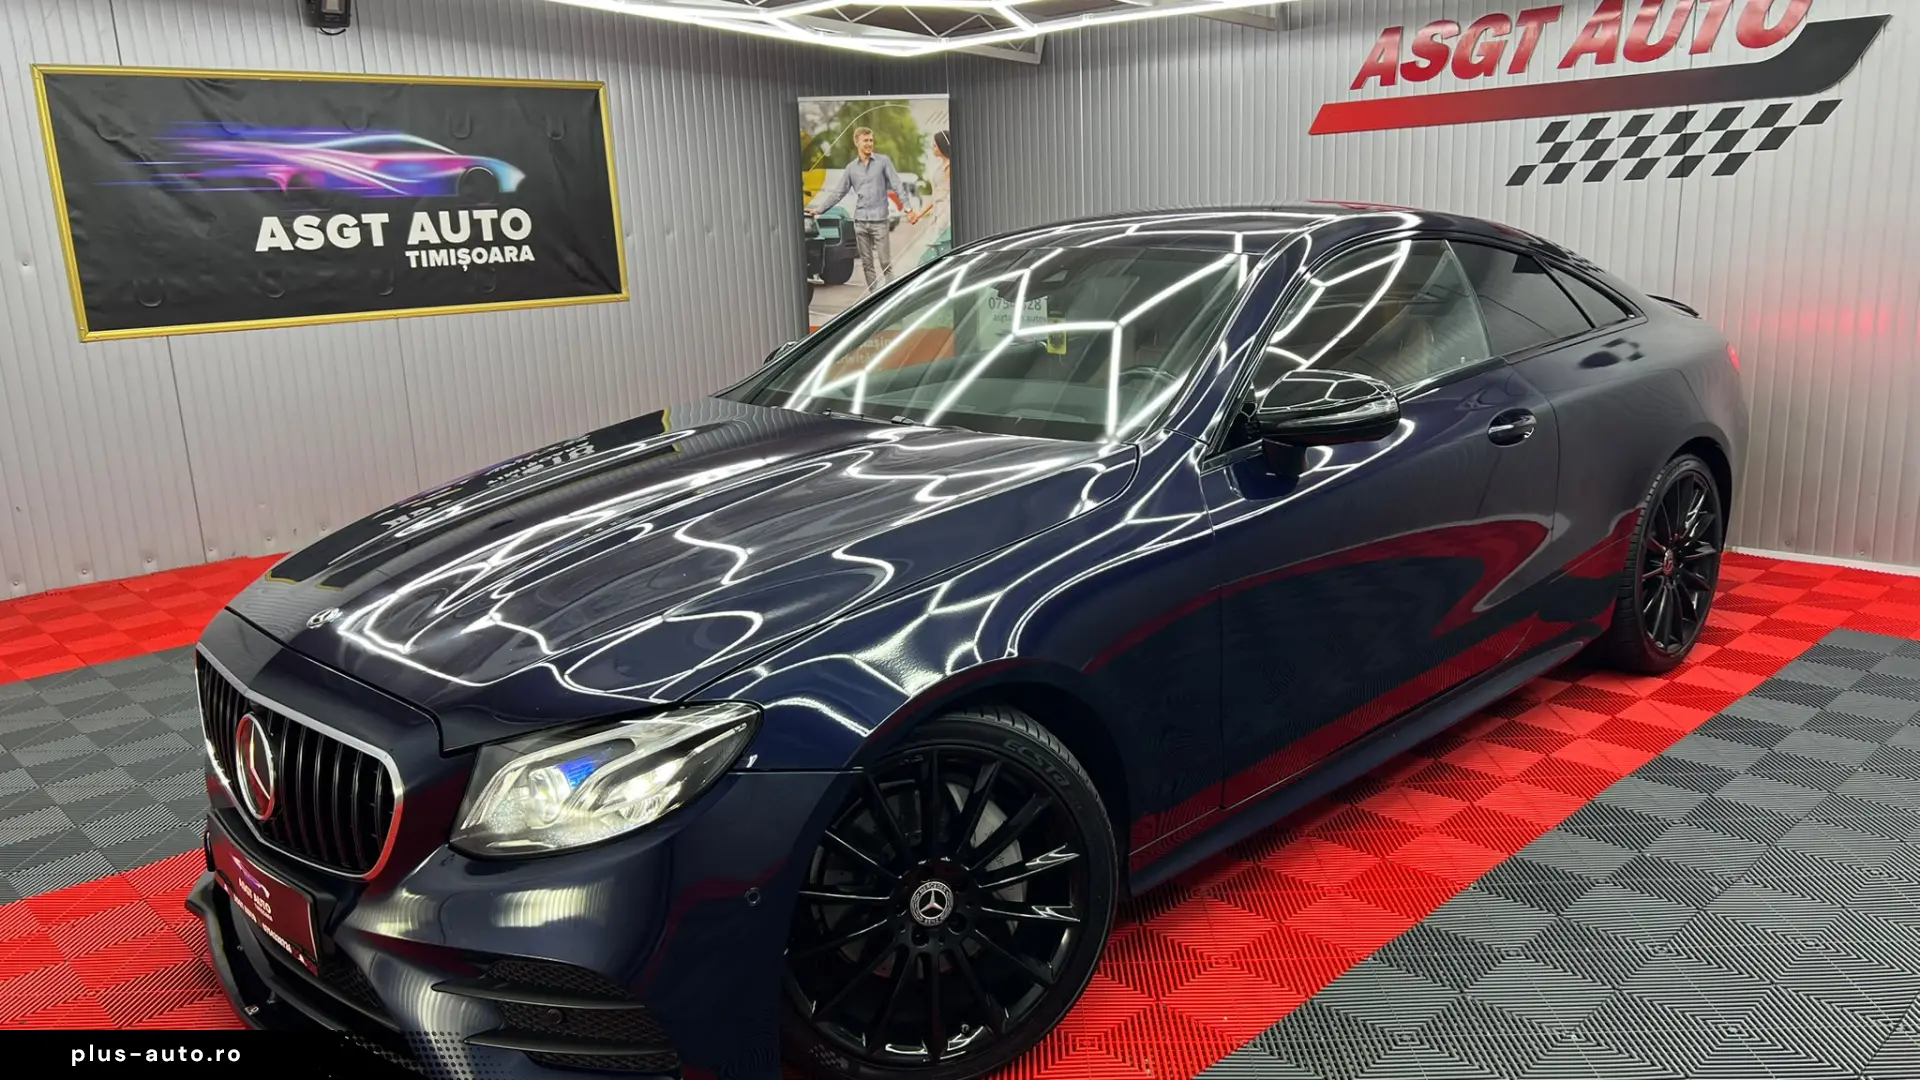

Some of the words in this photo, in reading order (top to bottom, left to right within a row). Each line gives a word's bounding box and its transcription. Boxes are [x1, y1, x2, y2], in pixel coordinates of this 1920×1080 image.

[1350, 5, 1564, 90] ASGT
[1557, 0, 1812, 69] AUTO
[255, 213, 390, 252] ASGT
[407, 208, 533, 245] AUTO
[405, 245, 536, 272] TIMIȘOARA
